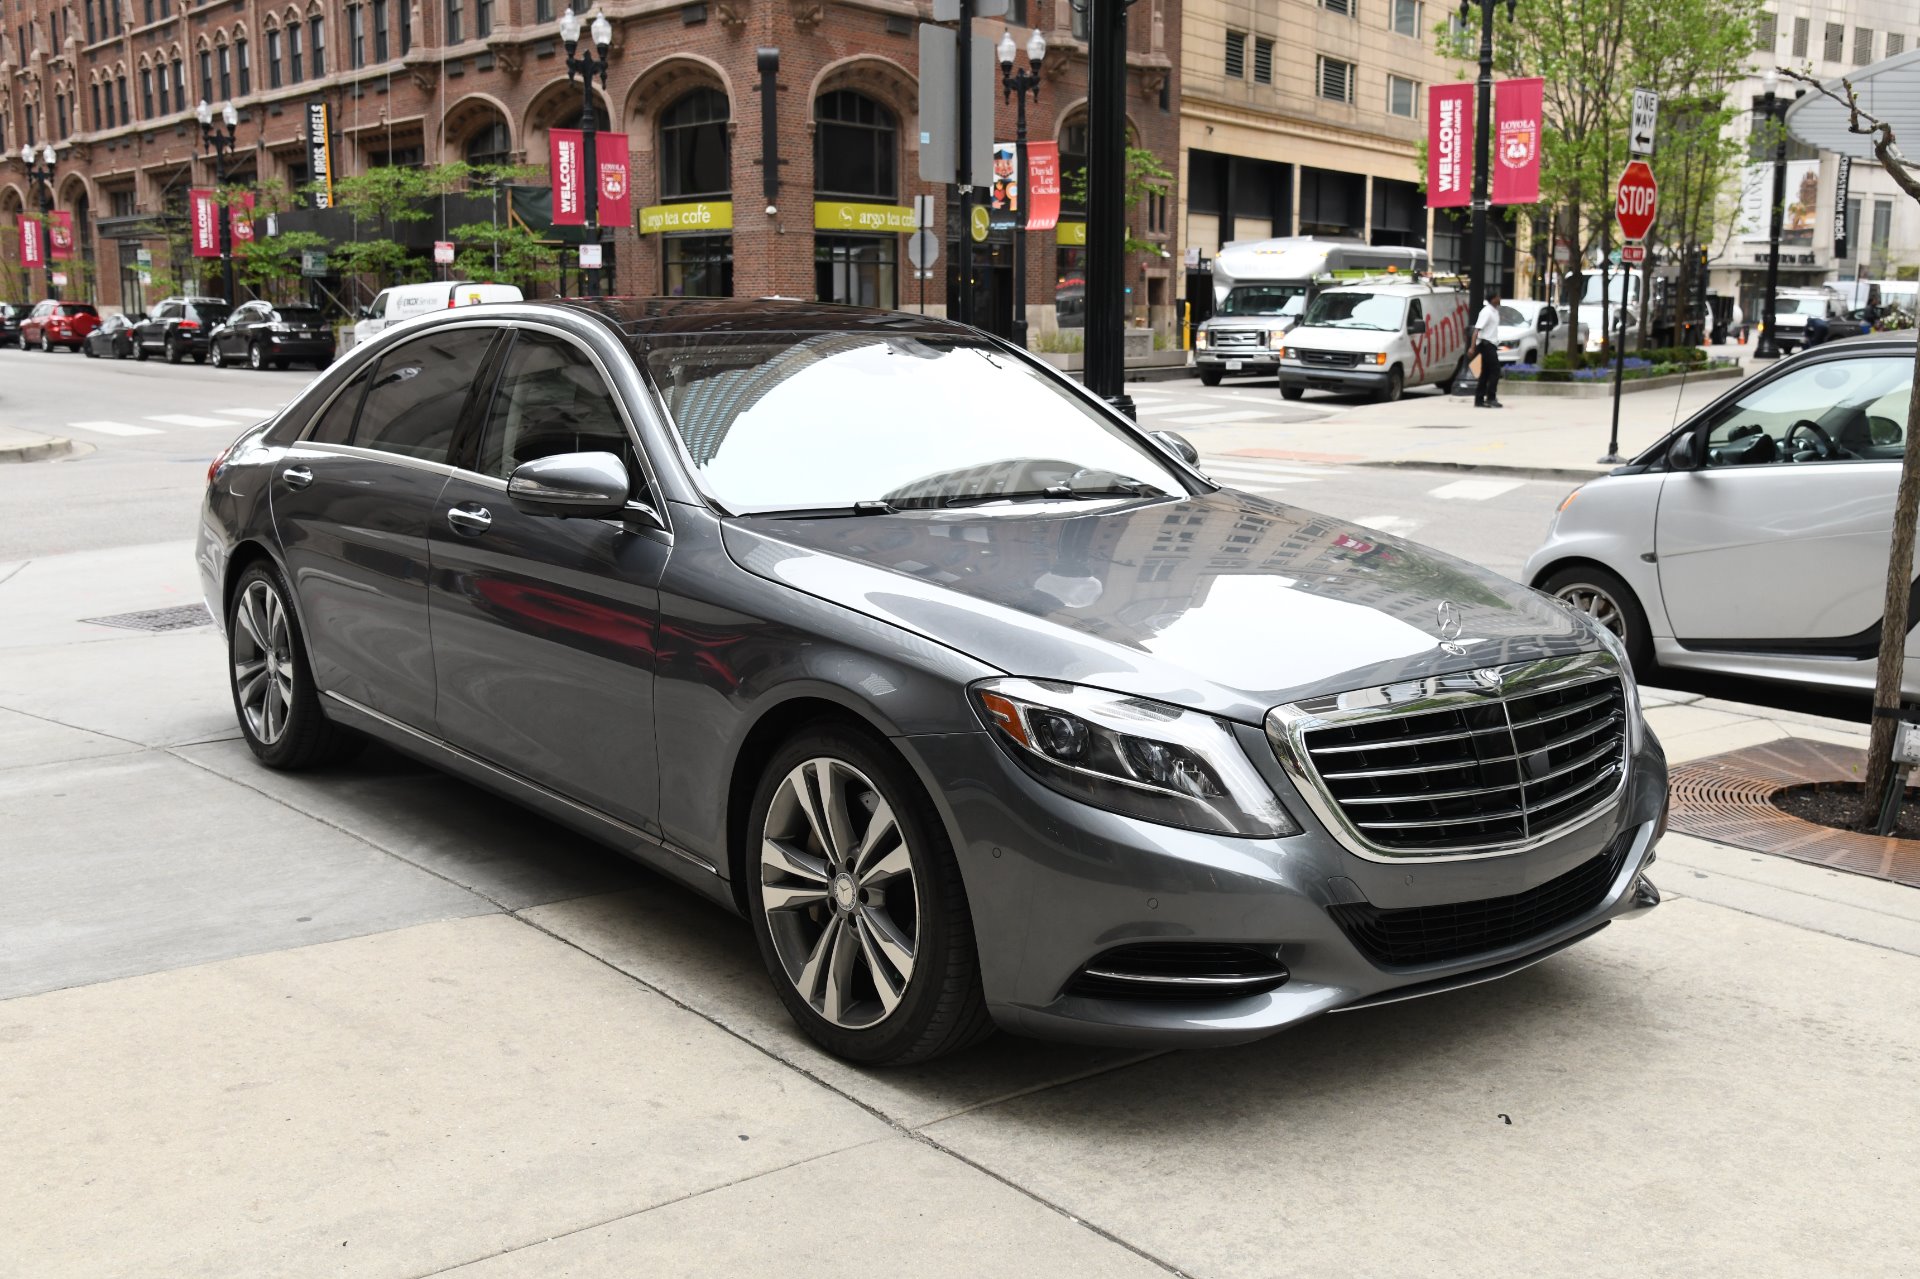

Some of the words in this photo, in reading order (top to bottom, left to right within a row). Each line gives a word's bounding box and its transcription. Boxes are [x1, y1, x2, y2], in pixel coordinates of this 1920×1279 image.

[1454, 99, 1462, 134] CAMPUS
[1636, 94, 1655, 112] ONE
[311, 104, 324, 143] BAGELS
[1500, 119, 1535, 129] LOYOLA
[1635, 112, 1654, 128] WAY
[1439, 99, 1453, 192] WELCOME
[1453, 134, 1461, 164] TOWER
[559, 141, 571, 213] WELCOME
[1031, 166, 1054, 176] David
[1041, 175, 1054, 184] Lee
[1836, 156, 1849, 212] ORDSTROM
[682, 203, 711, 224] café
[1619, 184, 1655, 216] STOP
[198, 198, 208, 248] WELCOME
[859, 212, 885, 229] argo
[1835, 214, 1846, 240] rack
